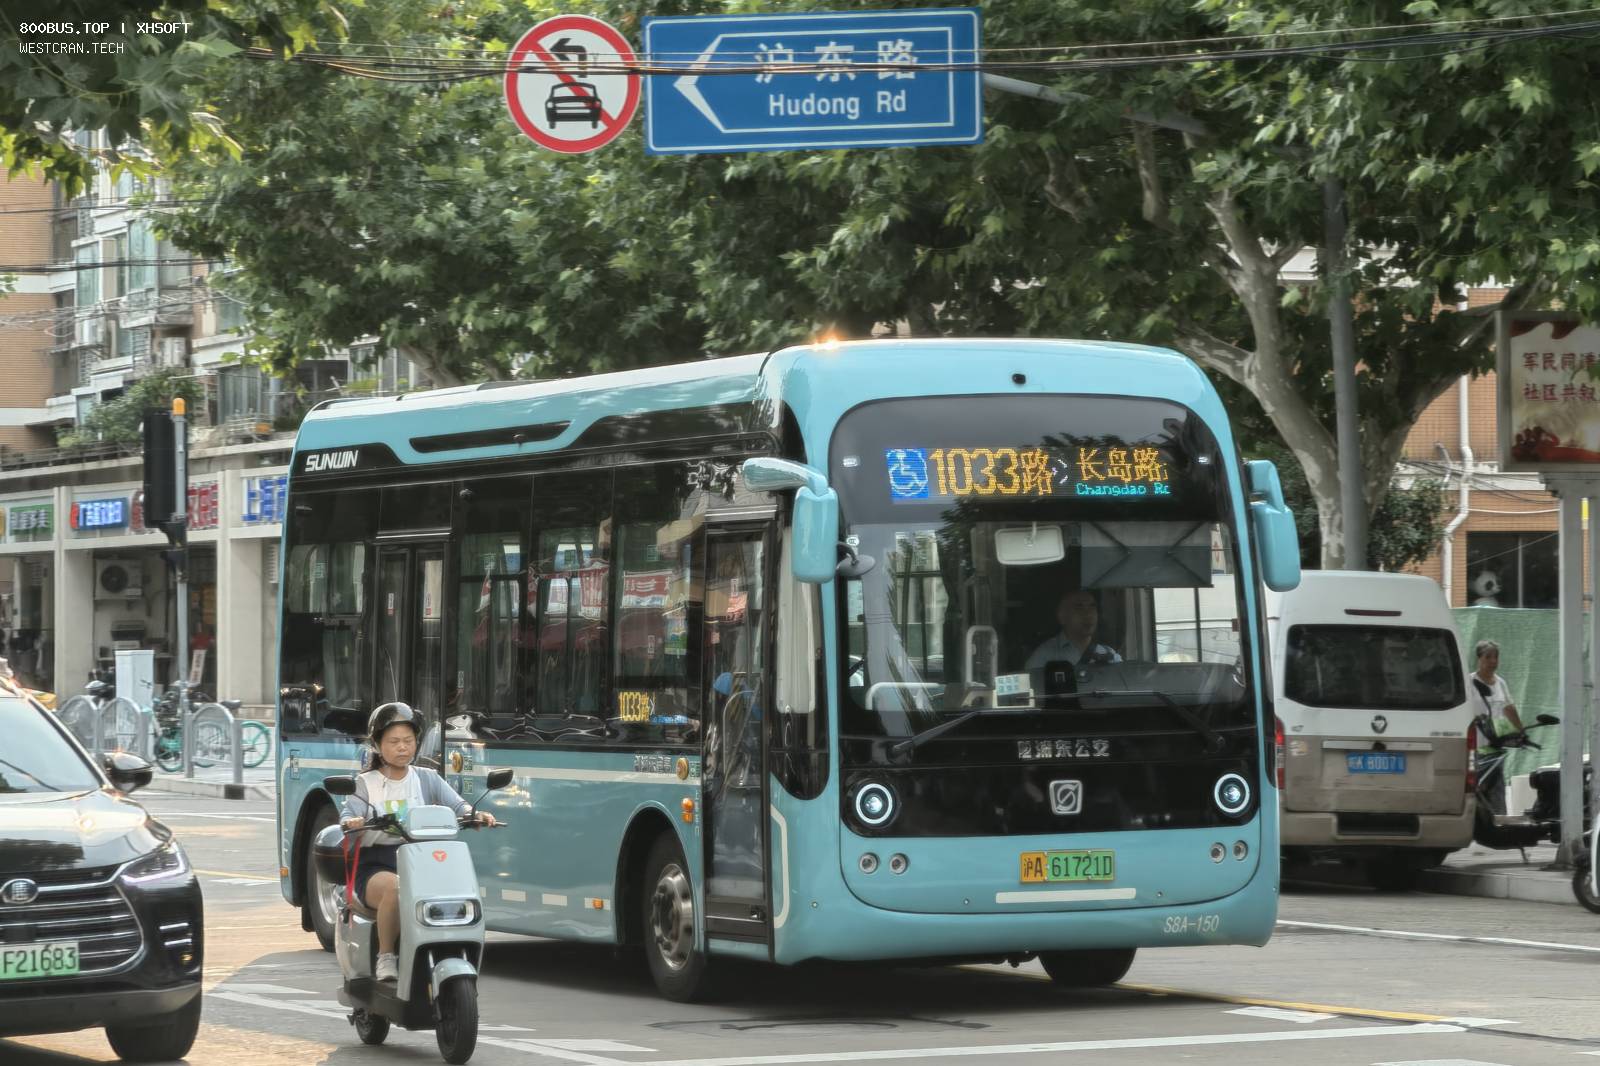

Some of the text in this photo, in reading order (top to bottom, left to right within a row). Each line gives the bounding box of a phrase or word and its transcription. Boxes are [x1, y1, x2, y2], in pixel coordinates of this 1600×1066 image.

[754, 39, 919, 84] 沪东路
[769, 89, 907, 120] Hudong Rd
[304, 450, 359, 472] SUNWIN
[929, 448, 1052, 496] 1033路
[1075, 447, 1169, 482] 长岛路
[1074, 482, 1148, 496] Changdao
[1051, 855, 1113, 878] 61721D
[1163, 914, 1220, 933] S8A-150
[3, 946, 77, 974] F21683
